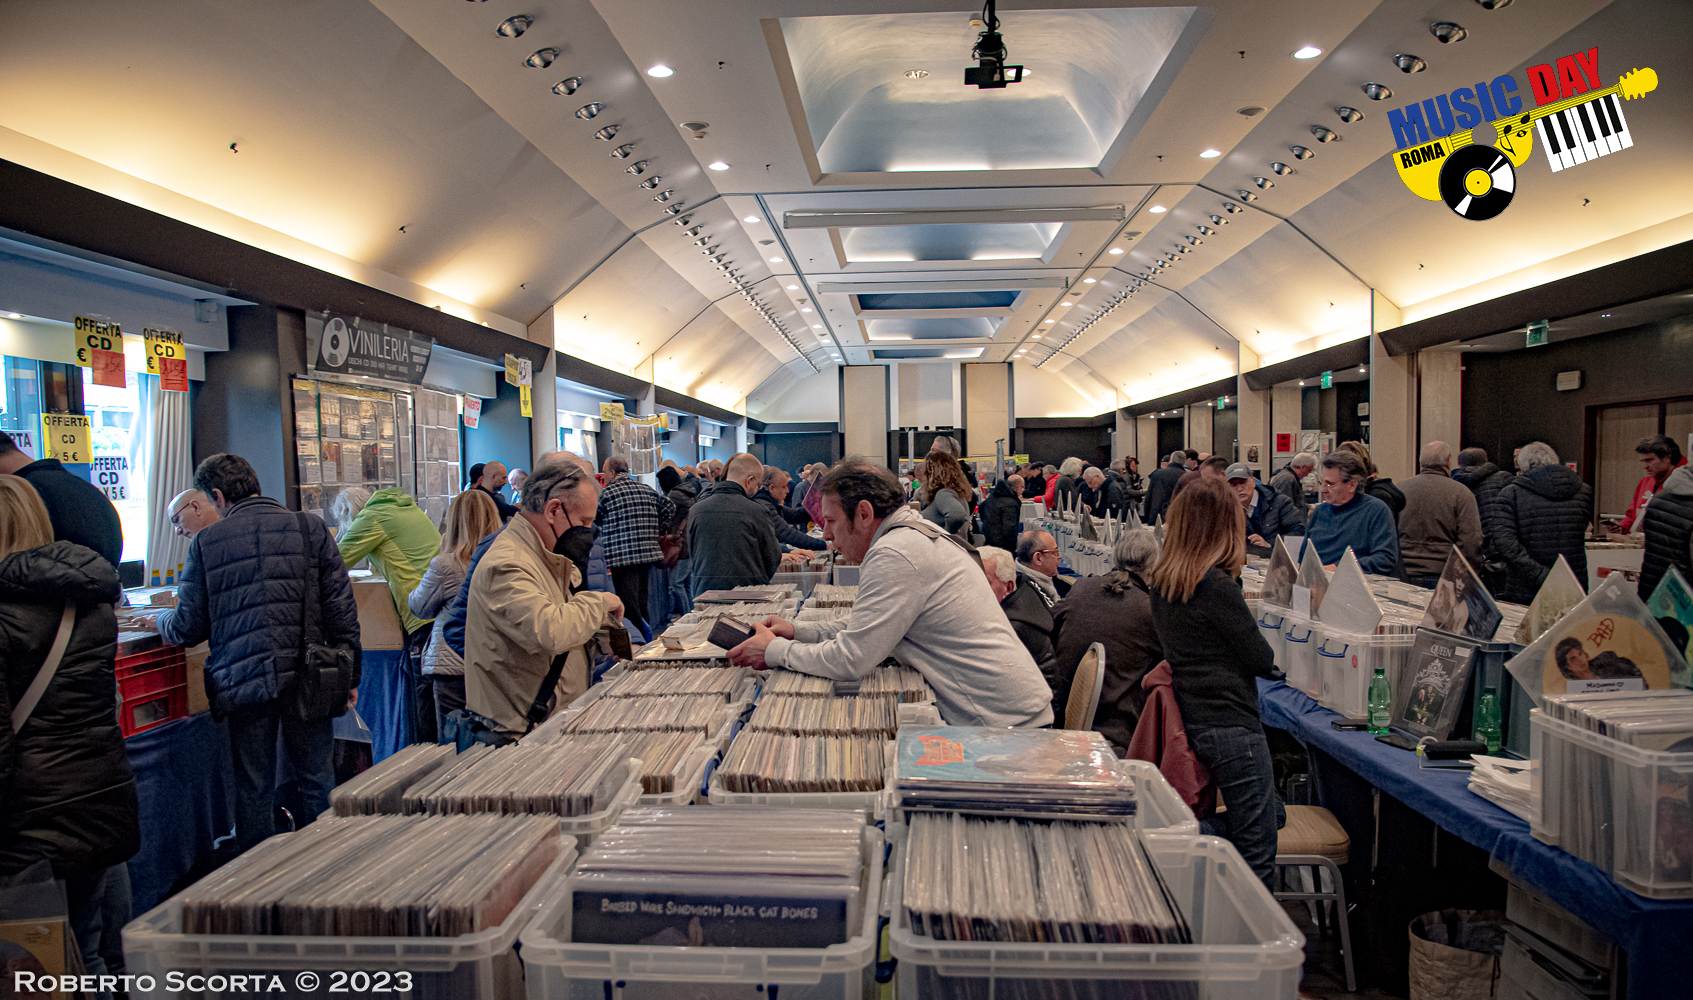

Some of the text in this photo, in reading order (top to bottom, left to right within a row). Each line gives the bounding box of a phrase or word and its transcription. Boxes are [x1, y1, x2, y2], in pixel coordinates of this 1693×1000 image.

[75, 316, 122, 339] OFFERTA
[86, 334, 112, 350] CD
[143, 327, 183, 345] OFFERTA
[154, 343, 175, 357] CD
[348, 327, 409, 363] VINILERIA
[76, 347, 87, 362] €
[147, 356, 155, 370] €
[43, 415, 90, 427] OFFERTA
[61, 434, 76, 444] CD
[91, 457, 129, 471] FFERTA
[98, 472, 119, 485] CD
[1430, 643, 1453, 658] QUEEN
[640, 901, 664, 914] WIRE
[723, 904, 755, 917] BLACK
[758, 906, 779, 918] CAT
[781, 907, 819, 919] BONES
